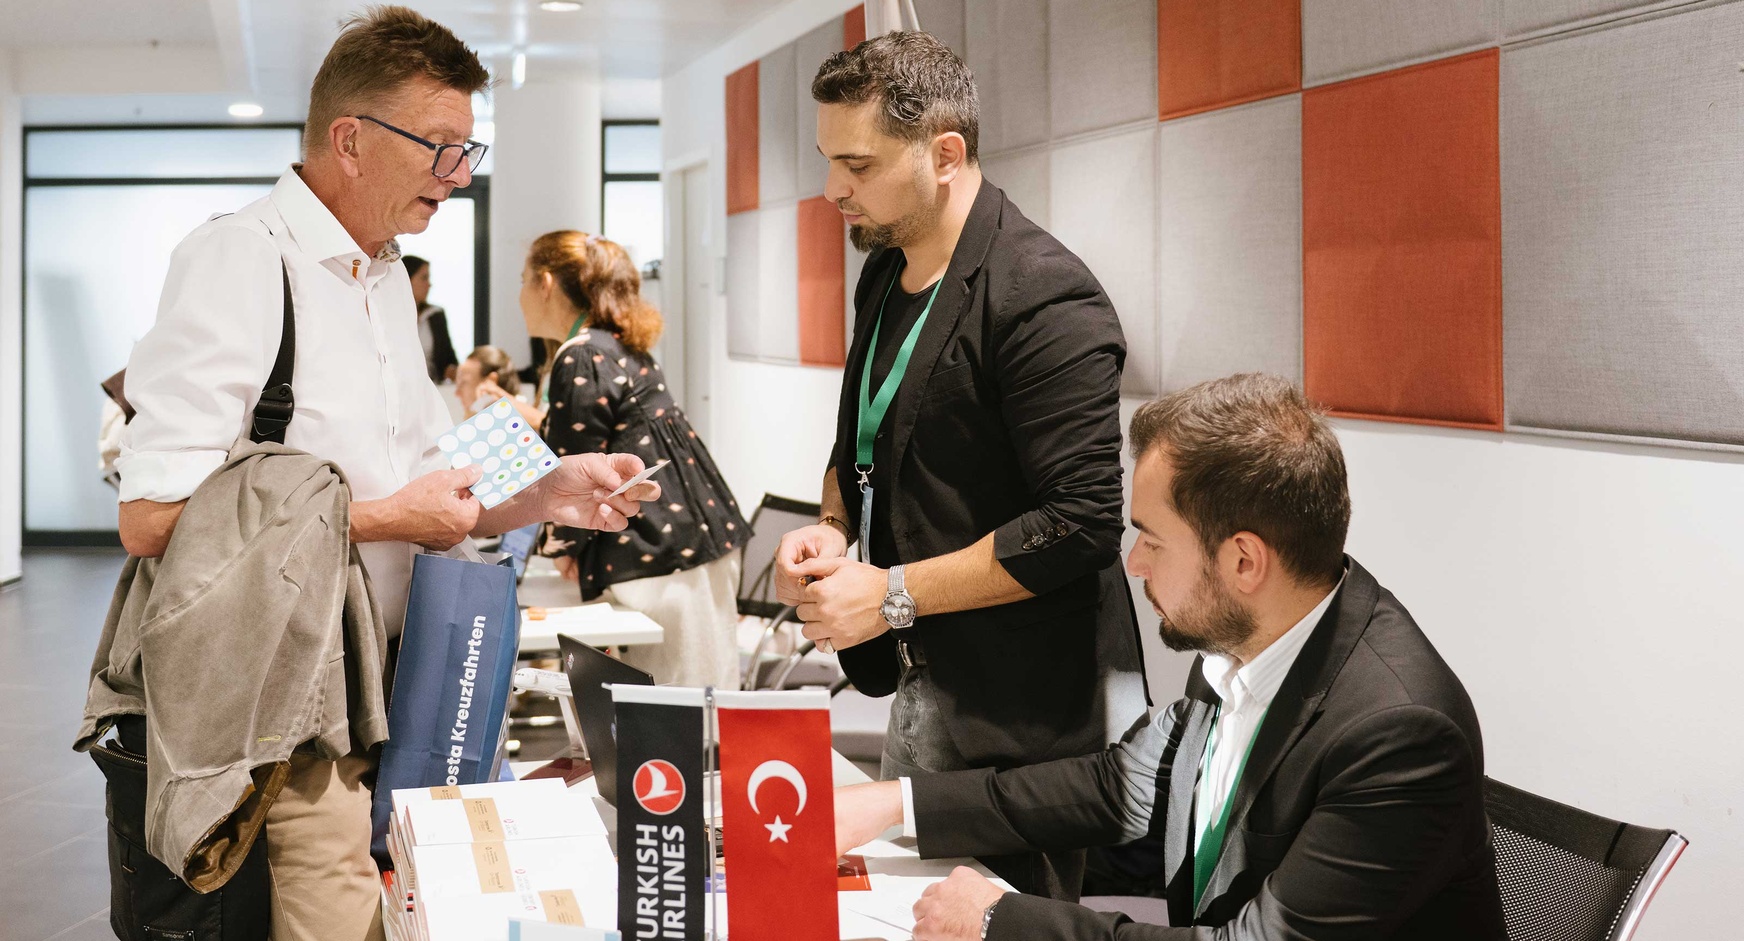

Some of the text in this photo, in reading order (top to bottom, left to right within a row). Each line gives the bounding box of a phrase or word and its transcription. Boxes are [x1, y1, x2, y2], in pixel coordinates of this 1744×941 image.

[451, 615, 487, 742] Kreuzfahrten
[446, 743, 464, 786] osta
[635, 824, 659, 941] URKISH
[661, 824, 686, 941] IRLINES
